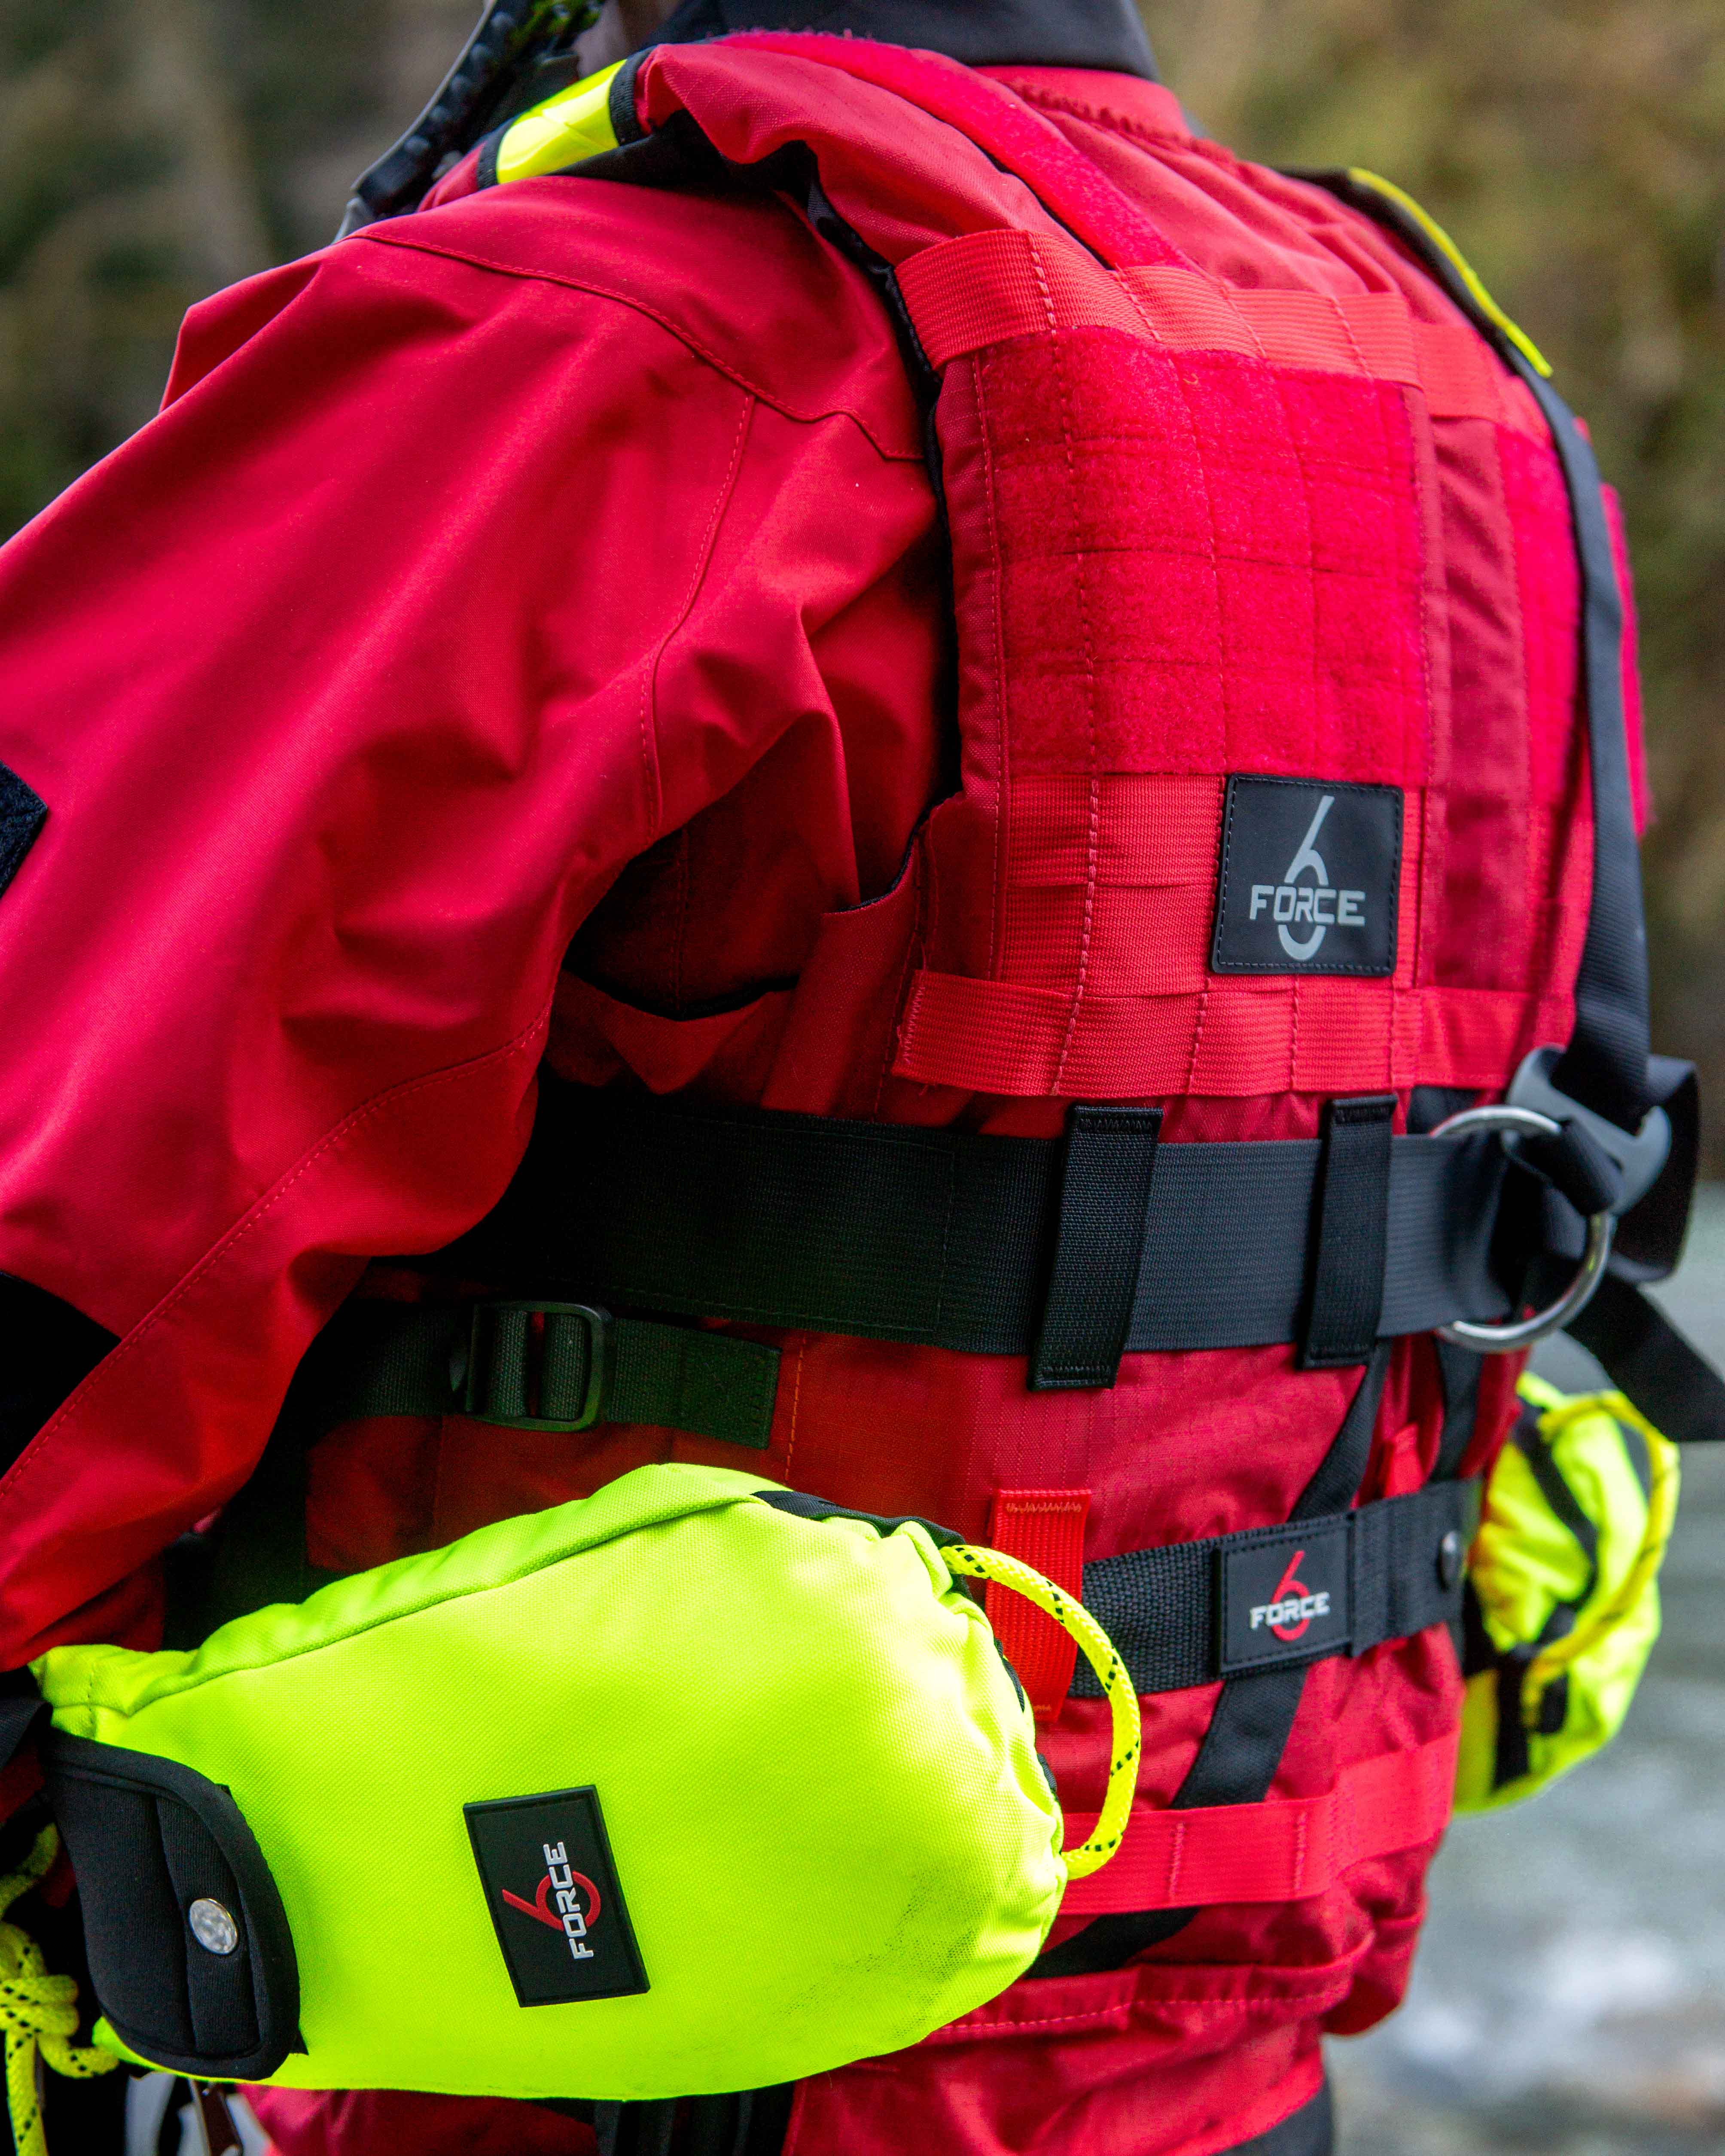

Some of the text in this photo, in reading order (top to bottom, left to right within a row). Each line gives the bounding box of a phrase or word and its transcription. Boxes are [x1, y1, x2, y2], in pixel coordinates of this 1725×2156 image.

[1250, 885, 1366, 927] FORCE
[1249, 1592, 1331, 1631] FORCE
[1270, 1550, 1311, 1642] 6
[502, 1870, 601, 1932] 6
[543, 1842, 594, 1959] FORCE
